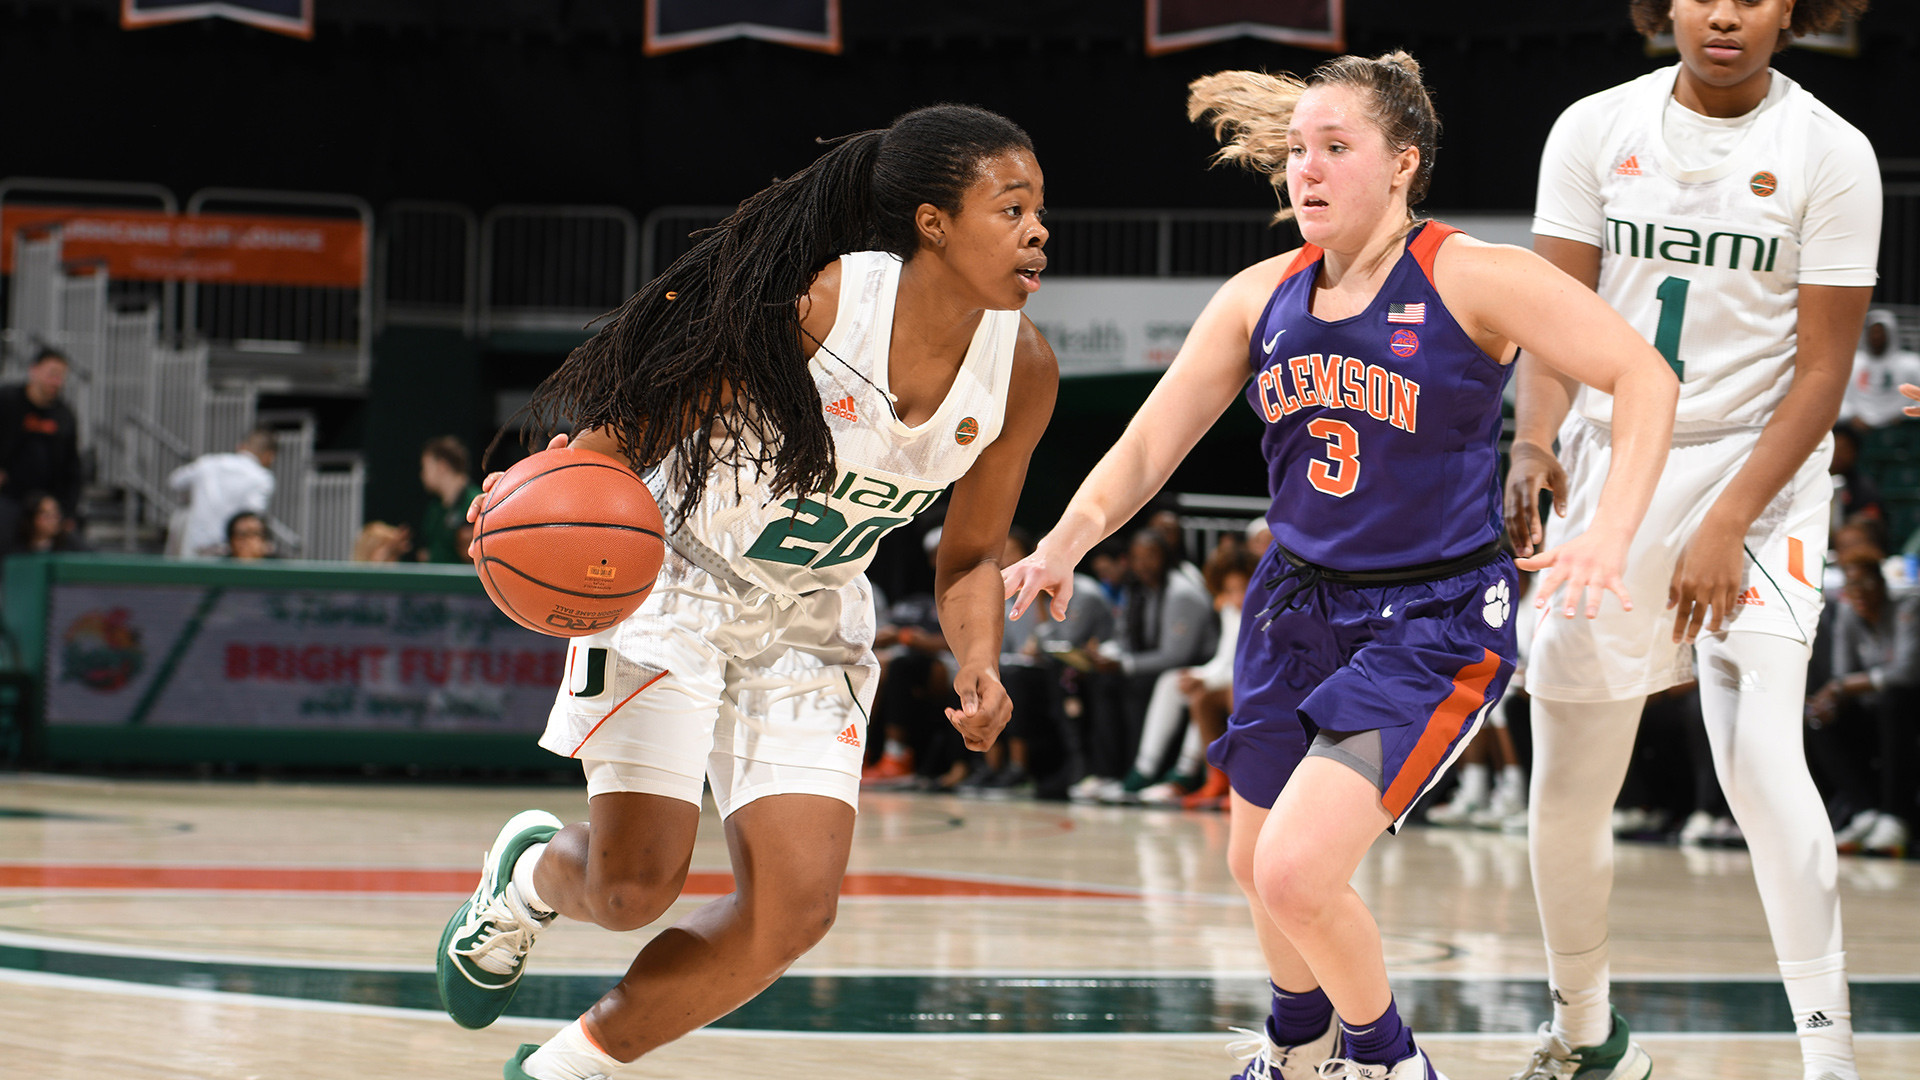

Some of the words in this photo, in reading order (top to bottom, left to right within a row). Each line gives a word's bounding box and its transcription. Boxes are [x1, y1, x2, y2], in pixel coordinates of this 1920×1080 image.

[1393, 337, 1416, 346] ACC
[1655, 276, 1690, 383] 1
[825, 404, 858, 423] adidas
[1257, 353, 1420, 434] CLEMSON
[1307, 417, 1361, 498] 3
[743, 498, 908, 570] 20
[545, 613, 618, 630] PRO
[555, 604, 574, 614] BALL
[575, 608, 597, 616] GAME
[225, 642, 389, 684] BRIGHT
[402, 648, 565, 687] FUTURE
[568, 645, 613, 699] U
